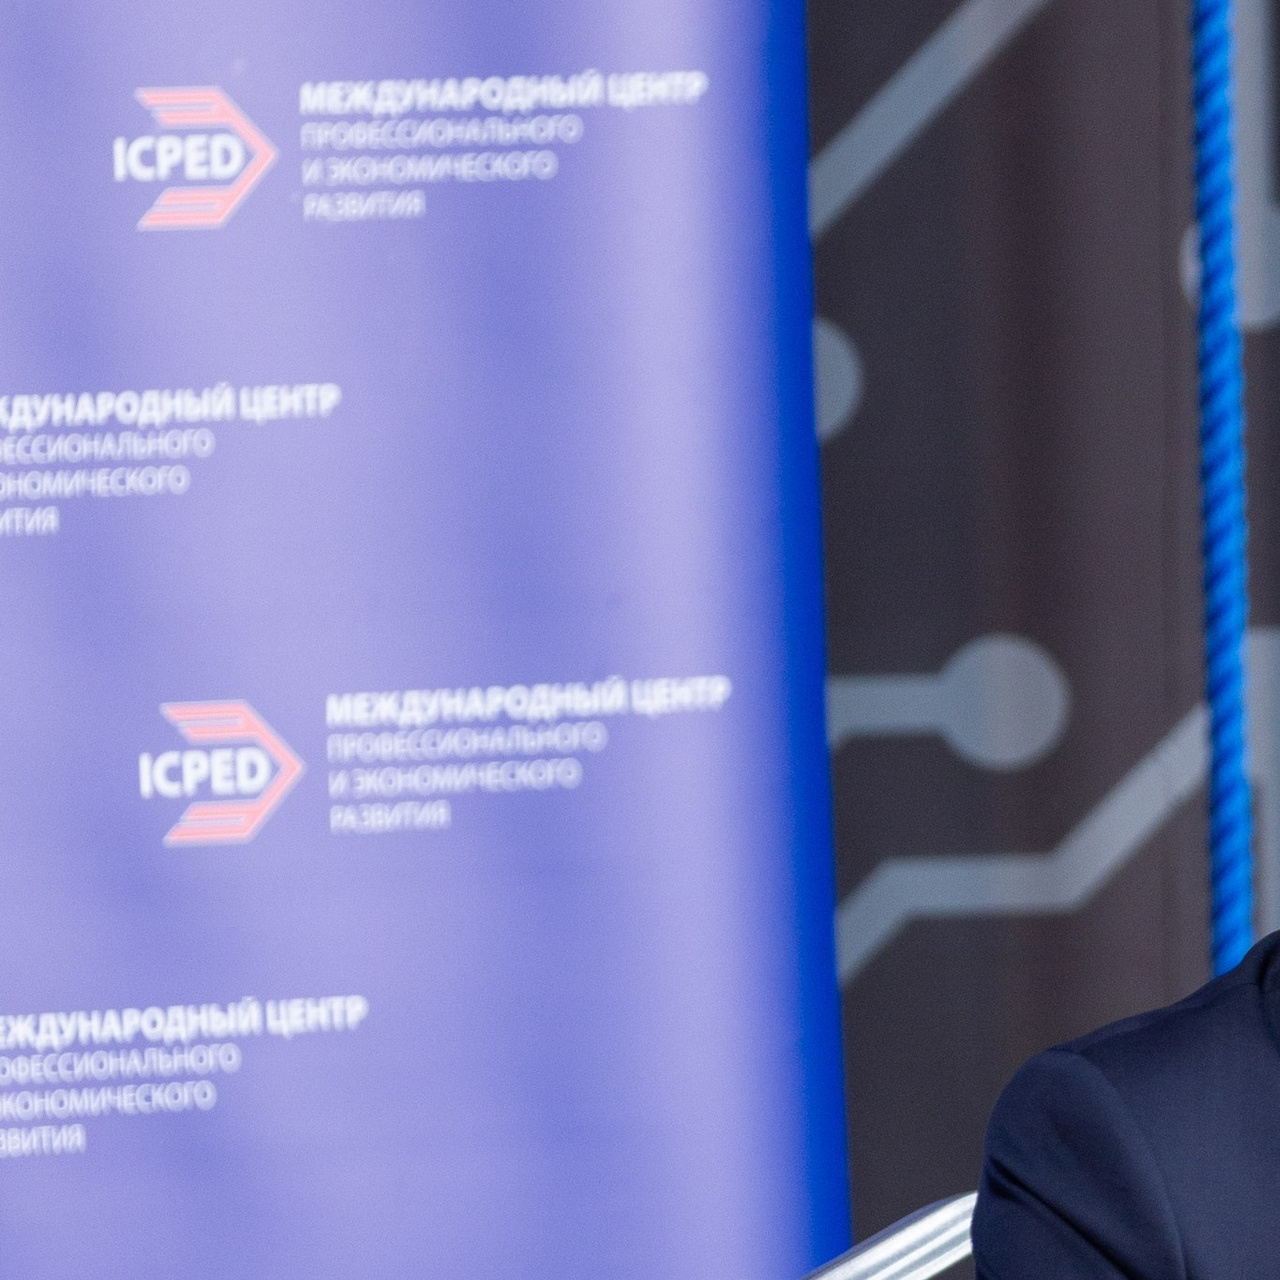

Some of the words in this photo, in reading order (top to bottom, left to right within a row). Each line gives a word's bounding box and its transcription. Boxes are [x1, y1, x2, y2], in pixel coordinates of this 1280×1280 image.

[300, 68, 604, 119] МЕЖДУНАРОДНЫЙ
[607, 70, 709, 112] ЦЕНТР
[301, 113, 584, 150] ПРОФЕССИОНАЛЬНОГО
[113, 132, 245, 182] ICPED
[303, 157, 323, 185] И
[326, 149, 559, 185] ЭКОНОМИЧЕСКОГО
[303, 189, 426, 220] РАЗВИТИЯ
[239, 382, 342, 427] ЦЕНТР
[0, 428, 216, 465] ЕССИОНАЛЬНОГО
[325, 675, 628, 730] МЕЖДУНАРОДНЫЙ
[630, 675, 732, 716] ЦЕНТР
[326, 720, 609, 763] ПРОФЕССИОНАЛЬНОГО
[139, 747, 272, 799] ICPED
[328, 771, 348, 798] И
[351, 758, 582, 798] ЭКОНОМИЧЕСКОГО
[329, 799, 451, 834] РАЗВИТИЯ
[265, 995, 369, 1041] ЦЕНТР
[0, 1080, 217, 1121] КОНОМИЧЕСКОГО
